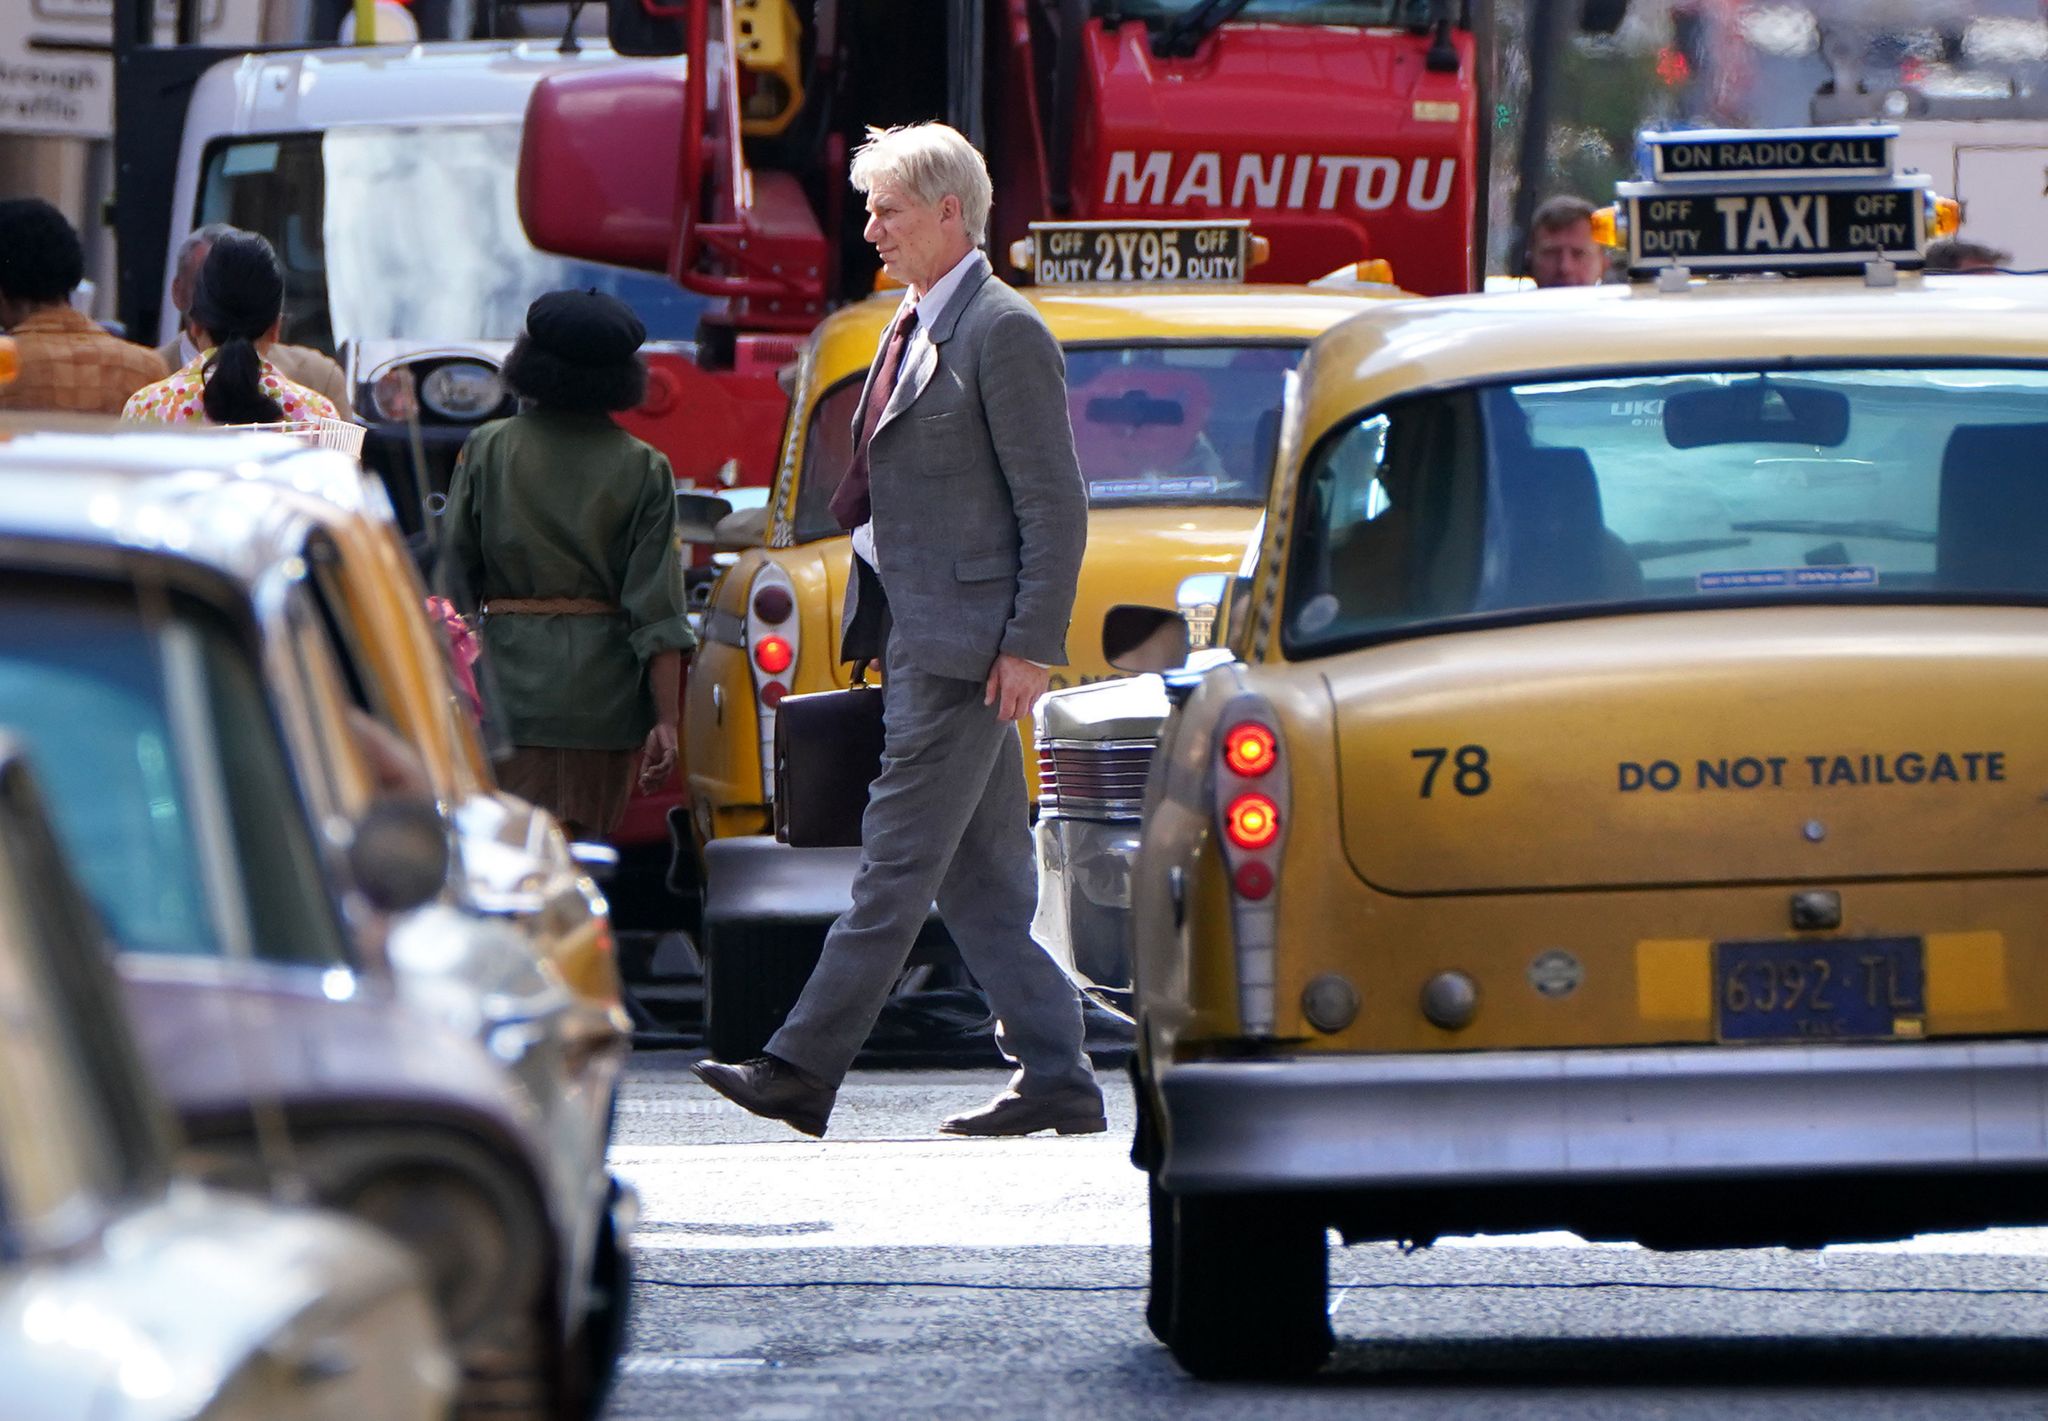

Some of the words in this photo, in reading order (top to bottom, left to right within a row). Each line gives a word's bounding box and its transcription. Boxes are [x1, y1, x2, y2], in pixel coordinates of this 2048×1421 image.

[1672, 144, 1713, 168] ON
[1719, 143, 1805, 166] RADIO
[1811, 141, 1878, 164] CALL
[1103, 150, 1456, 211] MANITOU
[1650, 200, 1693, 222] OFF
[1855, 195, 1898, 216] OFF
[1715, 194, 1830, 250] TAXI
[1050, 232, 1084, 255] OFF
[1195, 230, 1230, 253] OFF
[1643, 229, 1701, 251] DUTY
[1850, 223, 1907, 246] DUTY
[1095, 231, 1182, 281] 2Y95
[1187, 256, 1237, 280] DUTY
[1042, 258, 1093, 283] DUTY
[1411, 745, 1491, 798] 78
[1618, 759, 1682, 792] DO
[1697, 757, 1788, 790] NOT
[1806, 751, 2006, 786] TAILGATE
